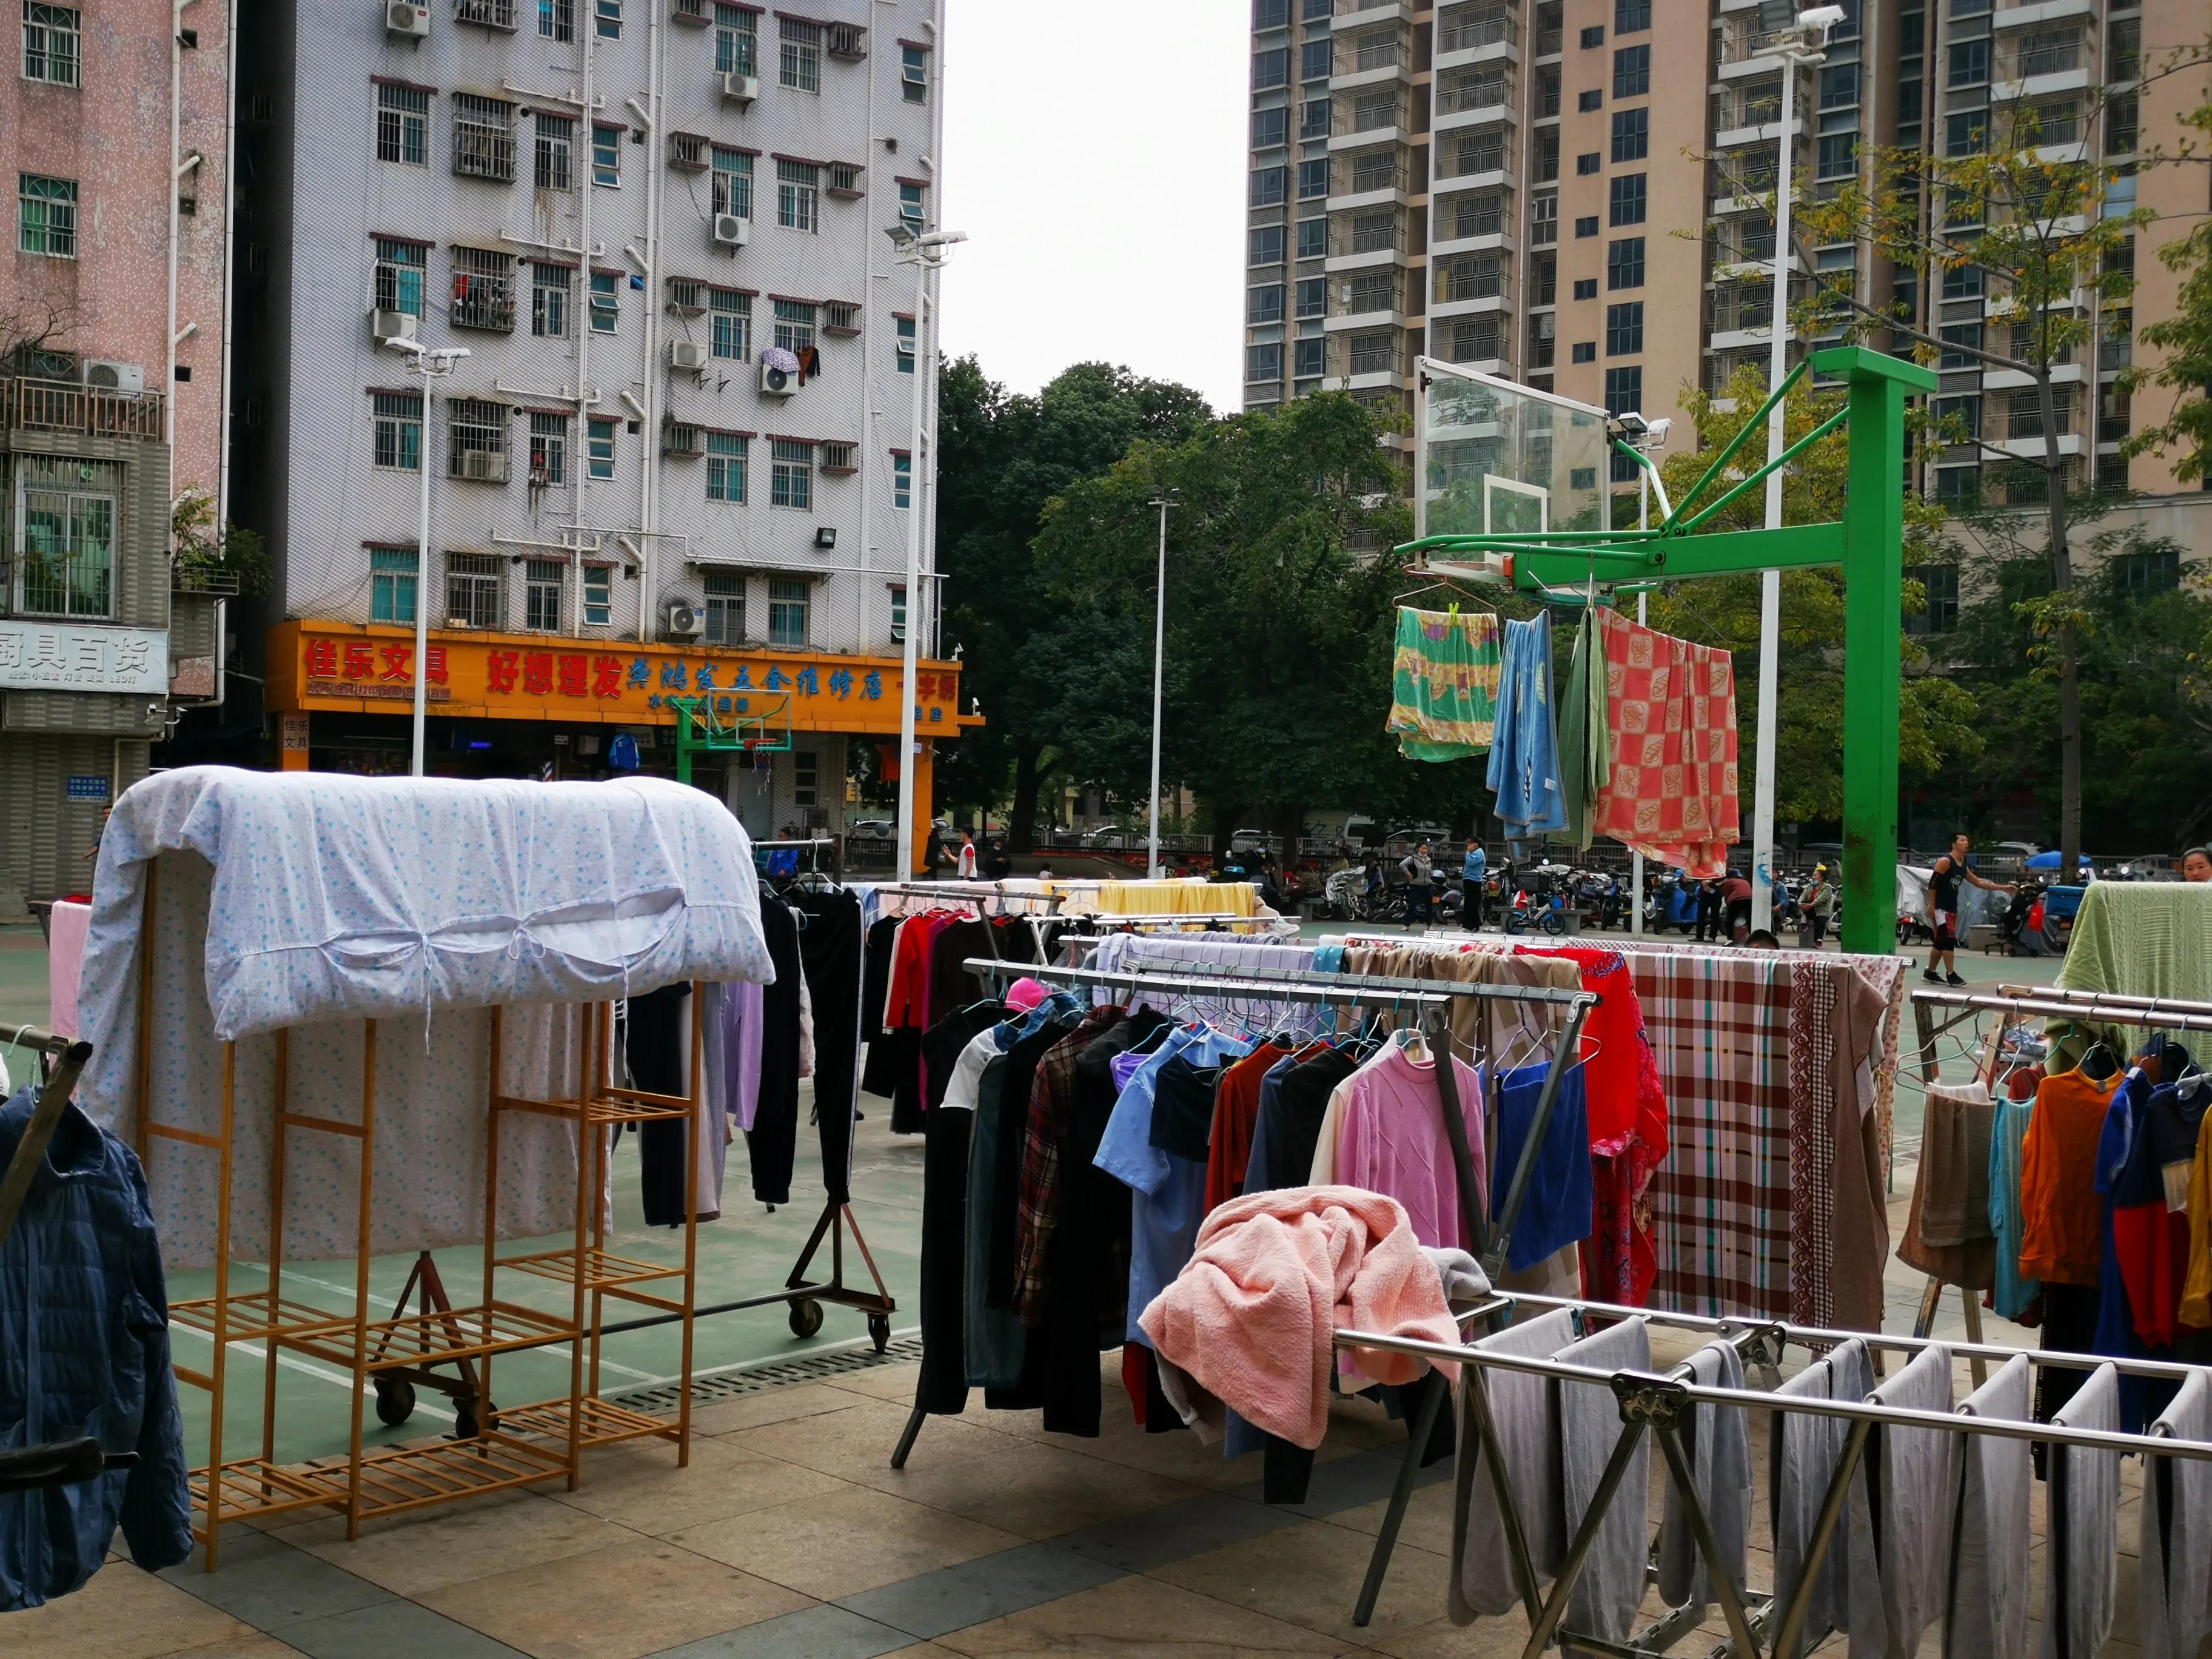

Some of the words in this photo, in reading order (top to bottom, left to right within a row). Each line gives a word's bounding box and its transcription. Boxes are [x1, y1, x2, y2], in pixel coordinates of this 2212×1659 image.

[305, 638, 449, 684] 佳乐文具
[488, 649, 623, 699] 好想理发
[896, 674, 956, 701] 字绣
[285, 719, 308, 732] 佳乐
[285, 736, 308, 748] 文具
